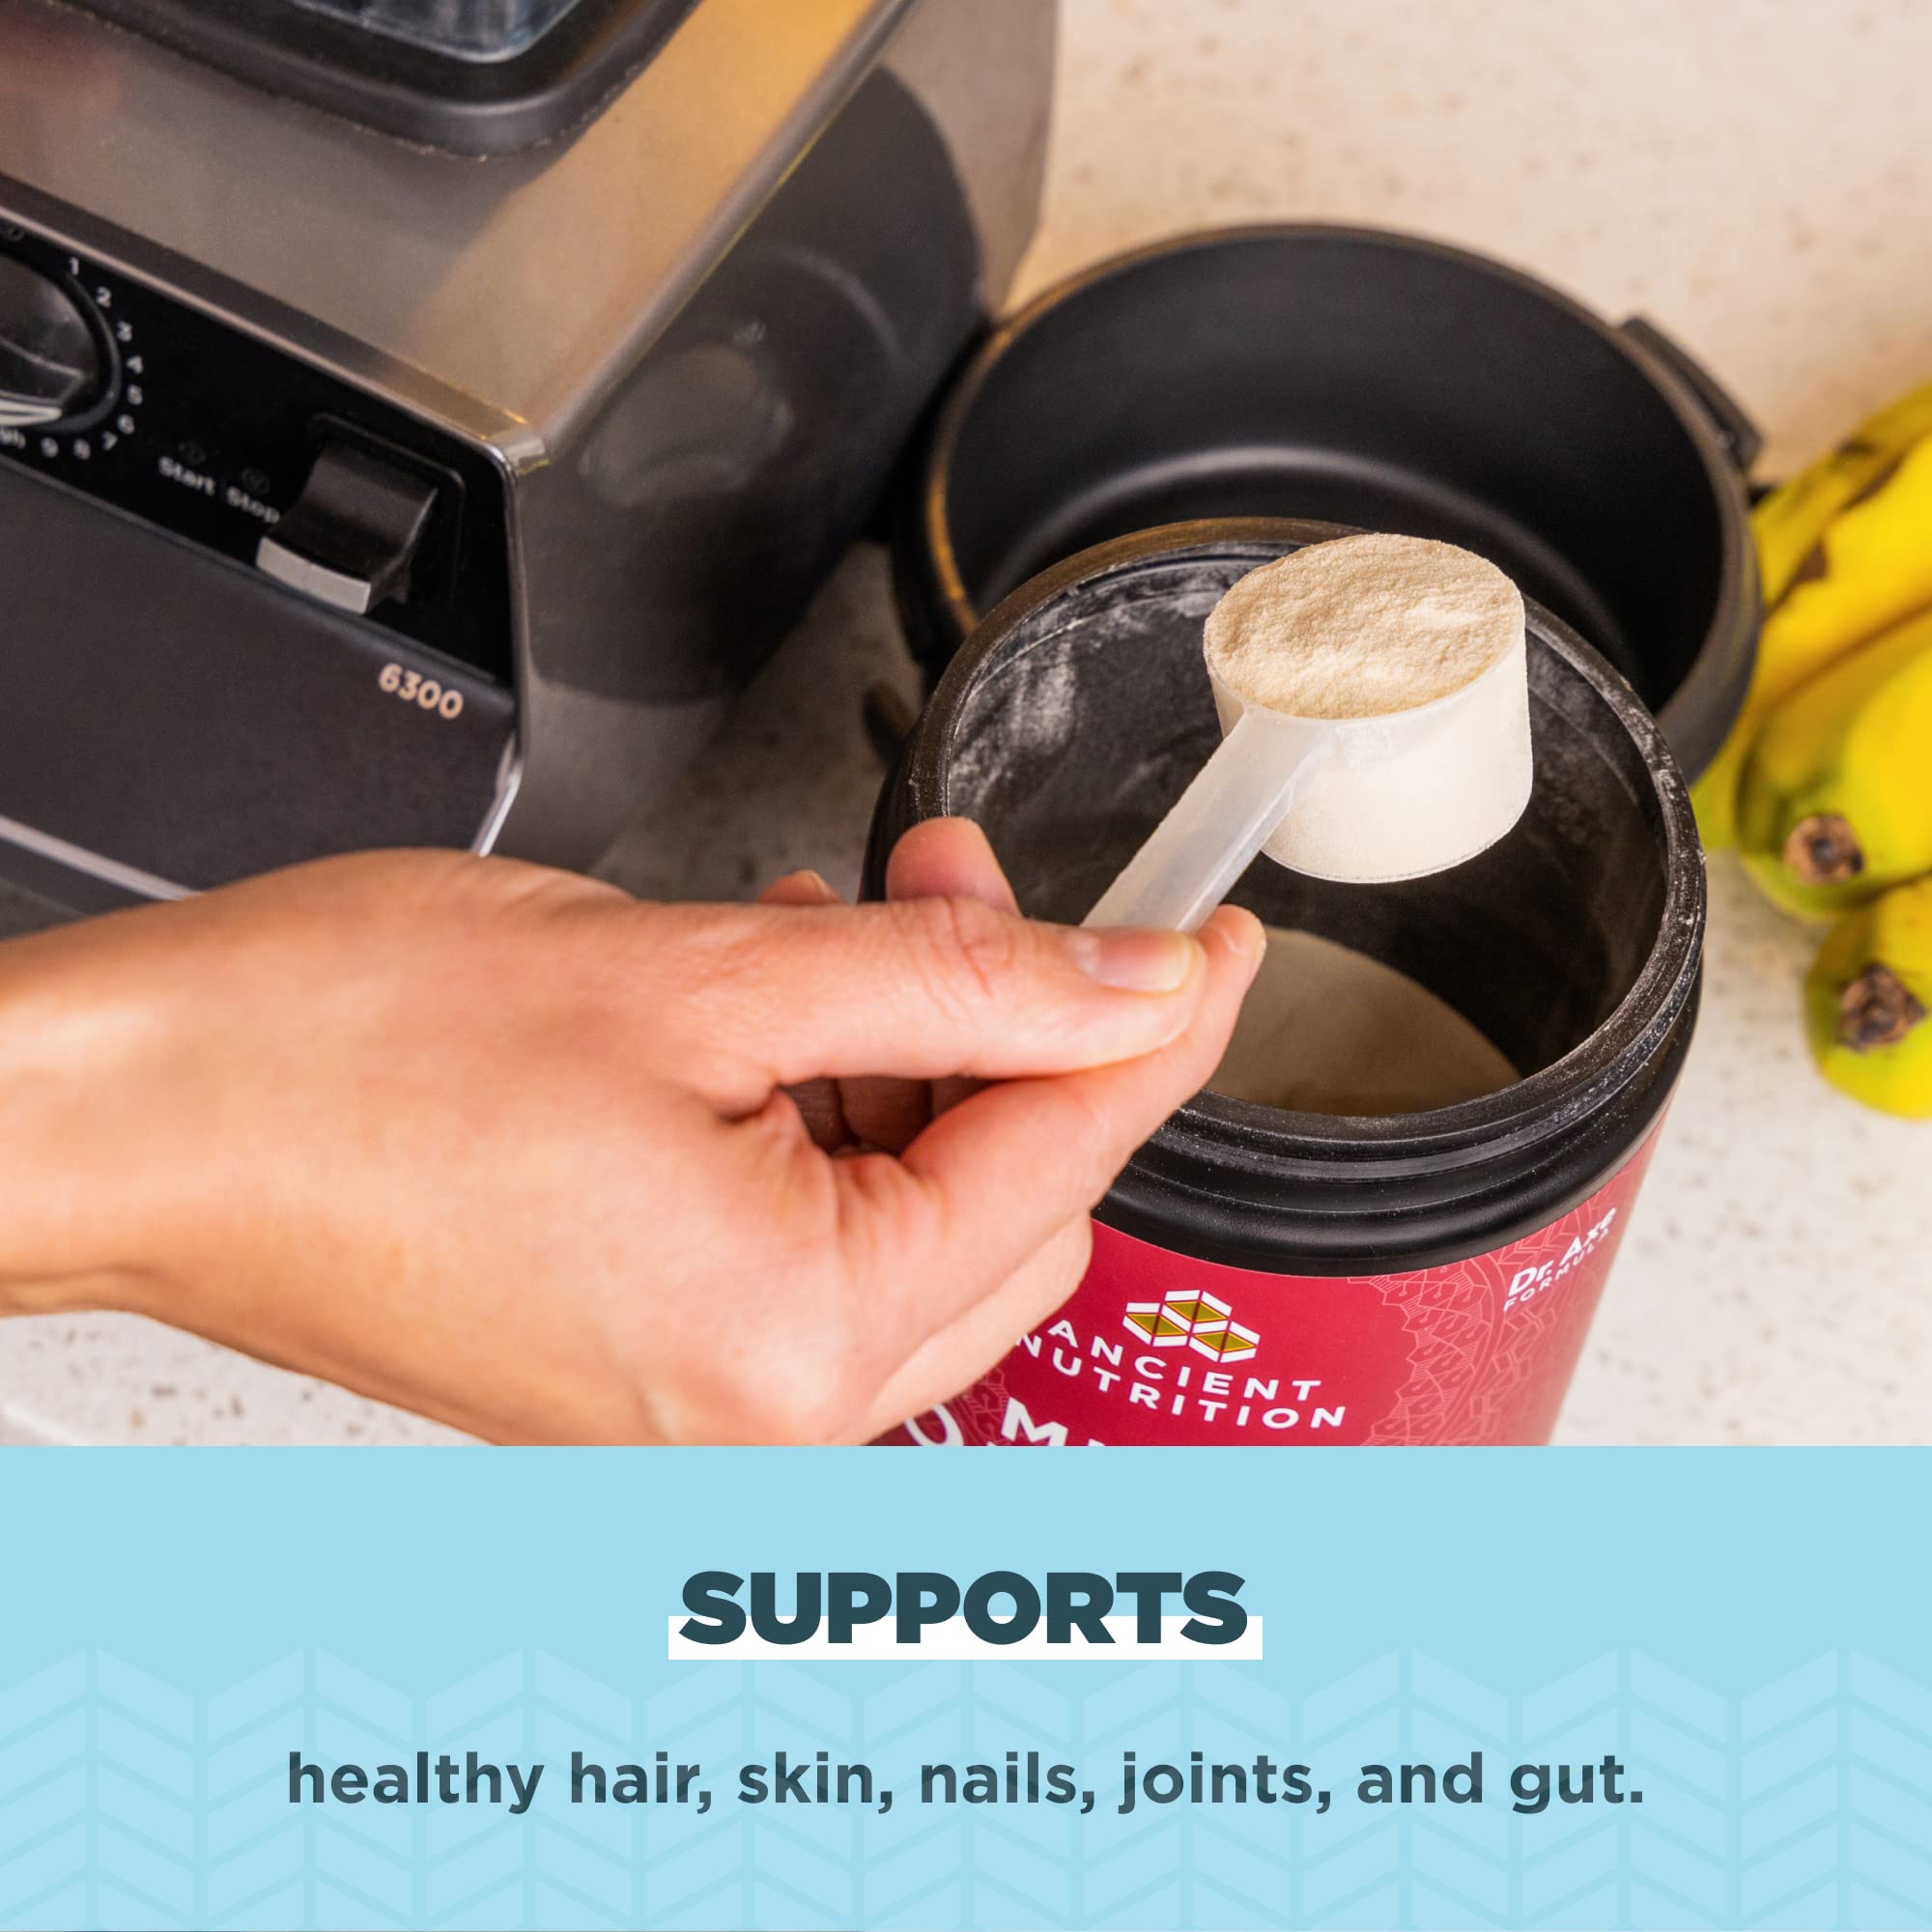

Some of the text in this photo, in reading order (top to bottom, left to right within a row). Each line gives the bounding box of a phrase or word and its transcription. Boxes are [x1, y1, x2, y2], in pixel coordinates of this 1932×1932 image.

[69, 257, 79, 275] 1
[97, 287, 112, 307] 2
[117, 321, 132, 341] 3
[127, 355, 144, 374] 4
[127, 384, 143, 405] 5
[101, 431, 118, 451] 7
[158, 456, 280, 524] Start Stop
[379, 663, 464, 720] 6300
[1508, 1260, 1553, 1296] Dr.
[1048, 1320, 1321, 1401] ANCIENT
[1016, 1333, 1346, 1429] NUTRITION
